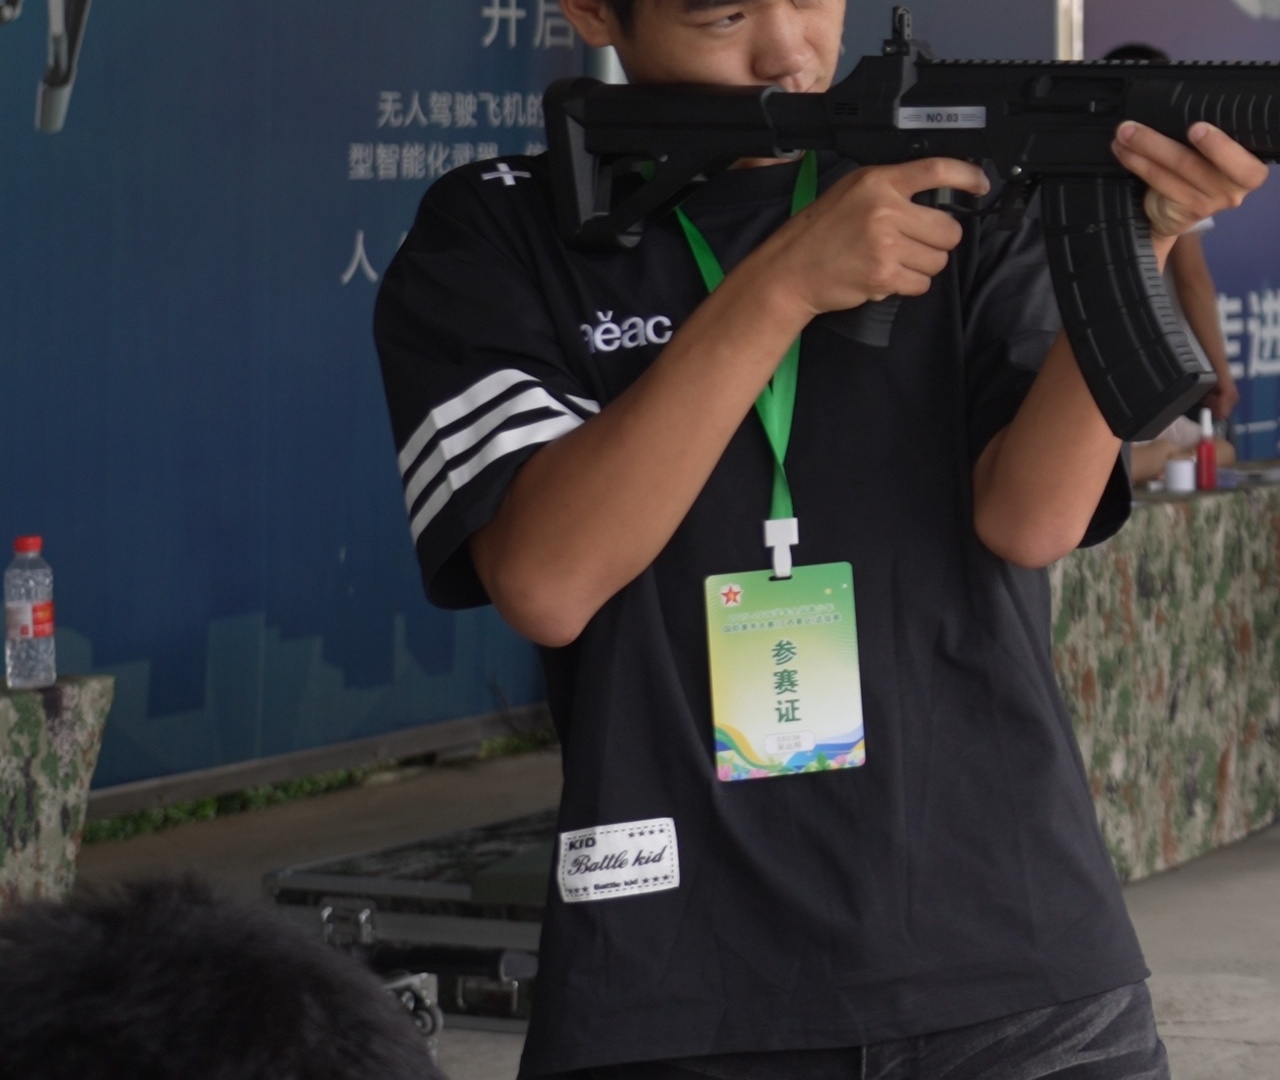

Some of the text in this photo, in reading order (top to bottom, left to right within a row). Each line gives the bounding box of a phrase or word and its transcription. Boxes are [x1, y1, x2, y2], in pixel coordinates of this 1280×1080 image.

[771, 639, 802, 724] 参赛证
[568, 837, 597, 852] KID
[567, 845, 669, 877] Battle kid
